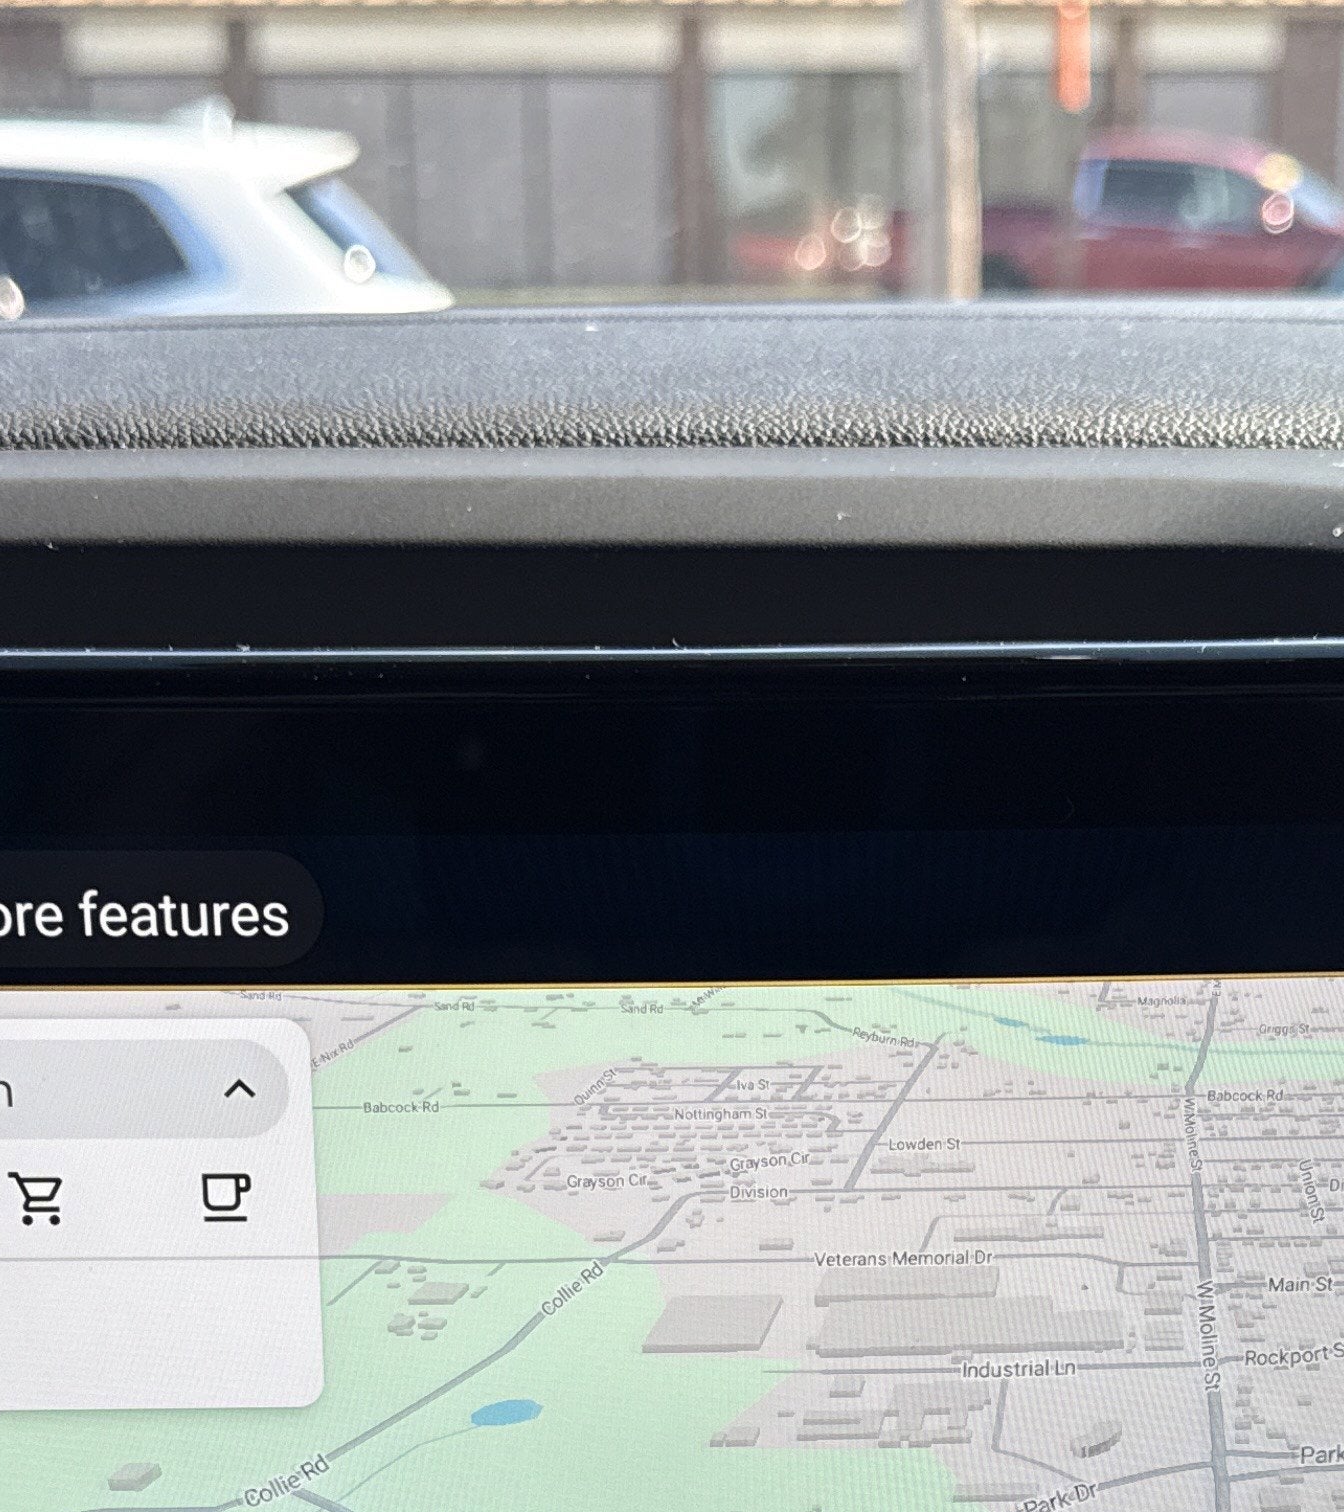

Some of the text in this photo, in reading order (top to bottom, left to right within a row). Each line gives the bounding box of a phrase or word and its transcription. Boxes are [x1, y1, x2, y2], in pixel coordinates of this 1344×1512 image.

[78, 889, 290, 938] features
[434, 999, 475, 1011] Sand Rd
[621, 1002, 664, 1014] Sand Rd
[852, 1026, 917, 1048] Reyburn Rd
[321, 1046, 339, 1066] Nix
[339, 1037, 356, 1054] Rd
[574, 1067, 618, 1106] Quinn St
[736, 1079, 770, 1091] Iva St
[1207, 1089, 1284, 1102] Babcock Rd
[363, 1101, 439, 1114] Babcock Rd
[674, 1108, 768, 1123] Nottingham St
[888, 1138, 961, 1152] Lowden St
[729, 1151, 810, 1174] Grayson Cir
[566, 1173, 648, 1192] Grayson Cir
[729, 1184, 789, 1201] Division
[1298, 1158, 1326, 1224] Union St
[814, 1249, 994, 1268] Veterans Memorial Dr
[539, 1259, 605, 1319] Collie Rd
[1268, 1276, 1334, 1293] Main St
[1196, 1279, 1221, 1393] W Moline St
[1244, 1342, 1328, 1368] Rockport
[962, 1358, 1077, 1379] Industrial Ln
[1300, 1443, 1344, 1464] Park
[243, 1451, 330, 1510] Collie Rd
[1072, 1479, 1099, 1505] Dr
